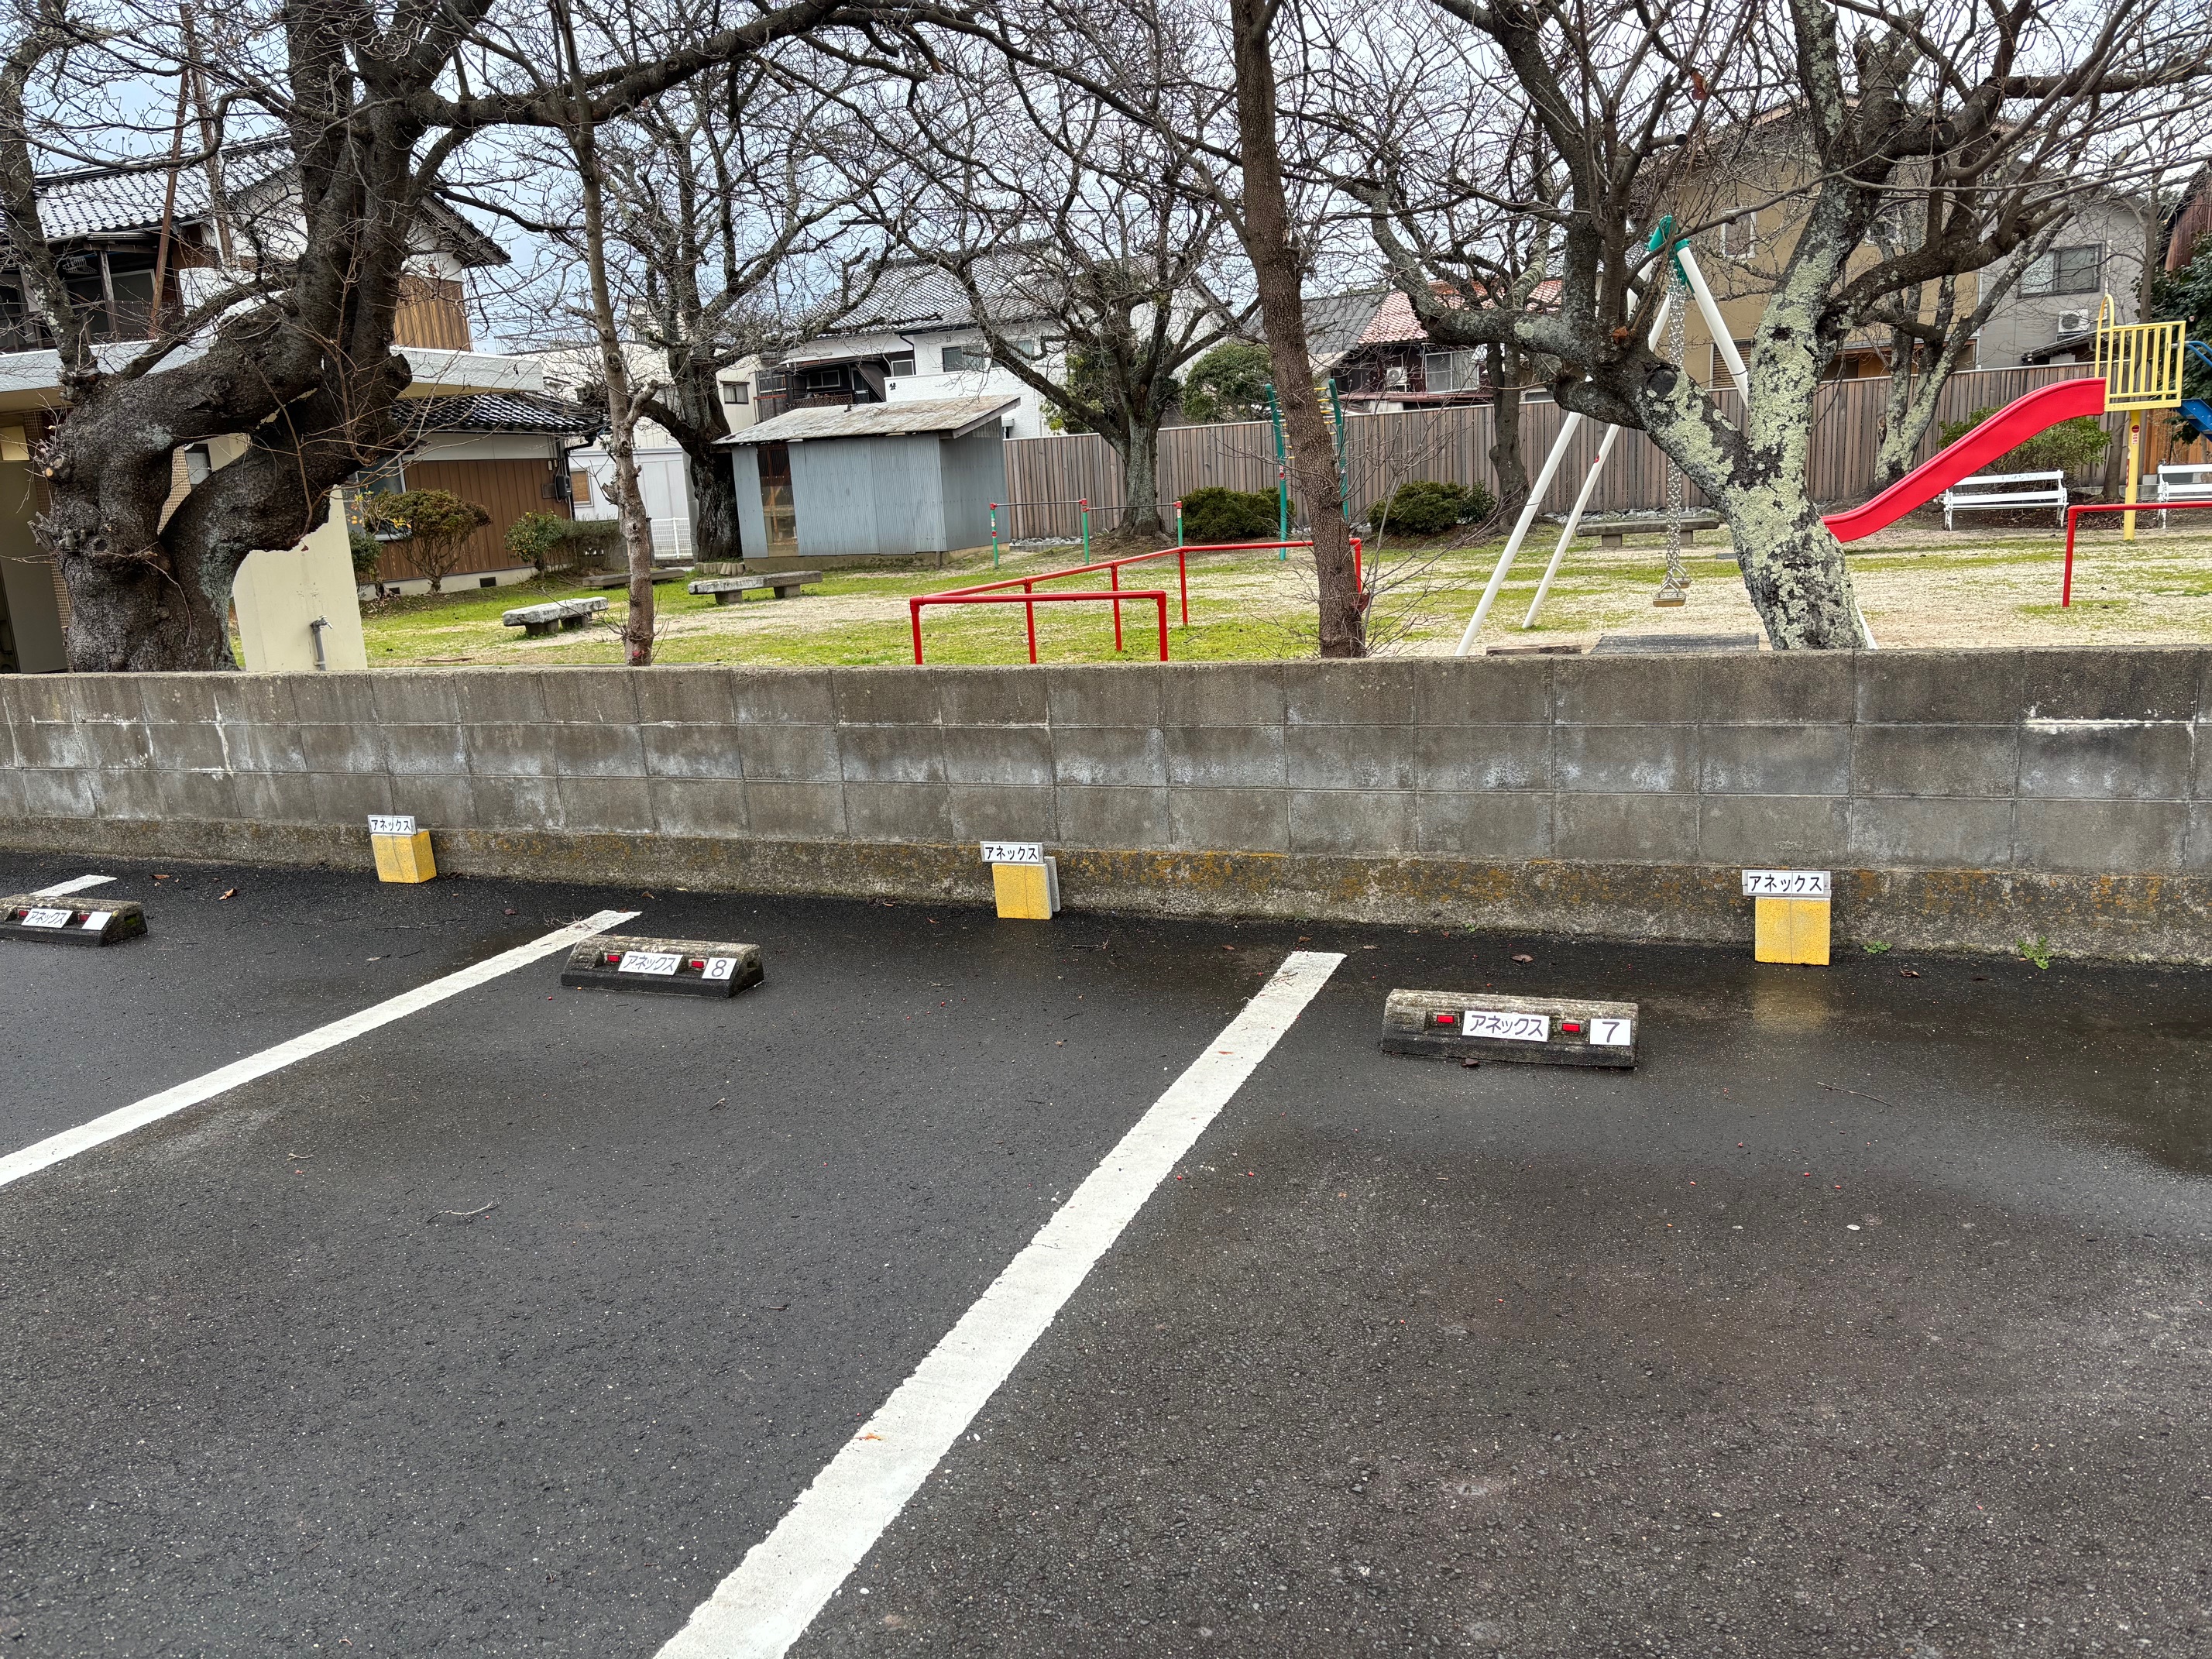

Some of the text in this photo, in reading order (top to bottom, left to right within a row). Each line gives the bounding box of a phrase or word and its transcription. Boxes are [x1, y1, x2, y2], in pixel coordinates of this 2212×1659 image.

[371, 819, 411, 831] アネックス
[985, 845, 1038, 860] アネックス
[1749, 874, 1822, 892] アネックス
[26, 911, 67, 925] アネックス
[623, 955, 676, 972] アネックス
[711, 959, 727, 977] 8
[1469, 1015, 1544, 1037] アネックス
[1602, 1021, 1620, 1043] 7
